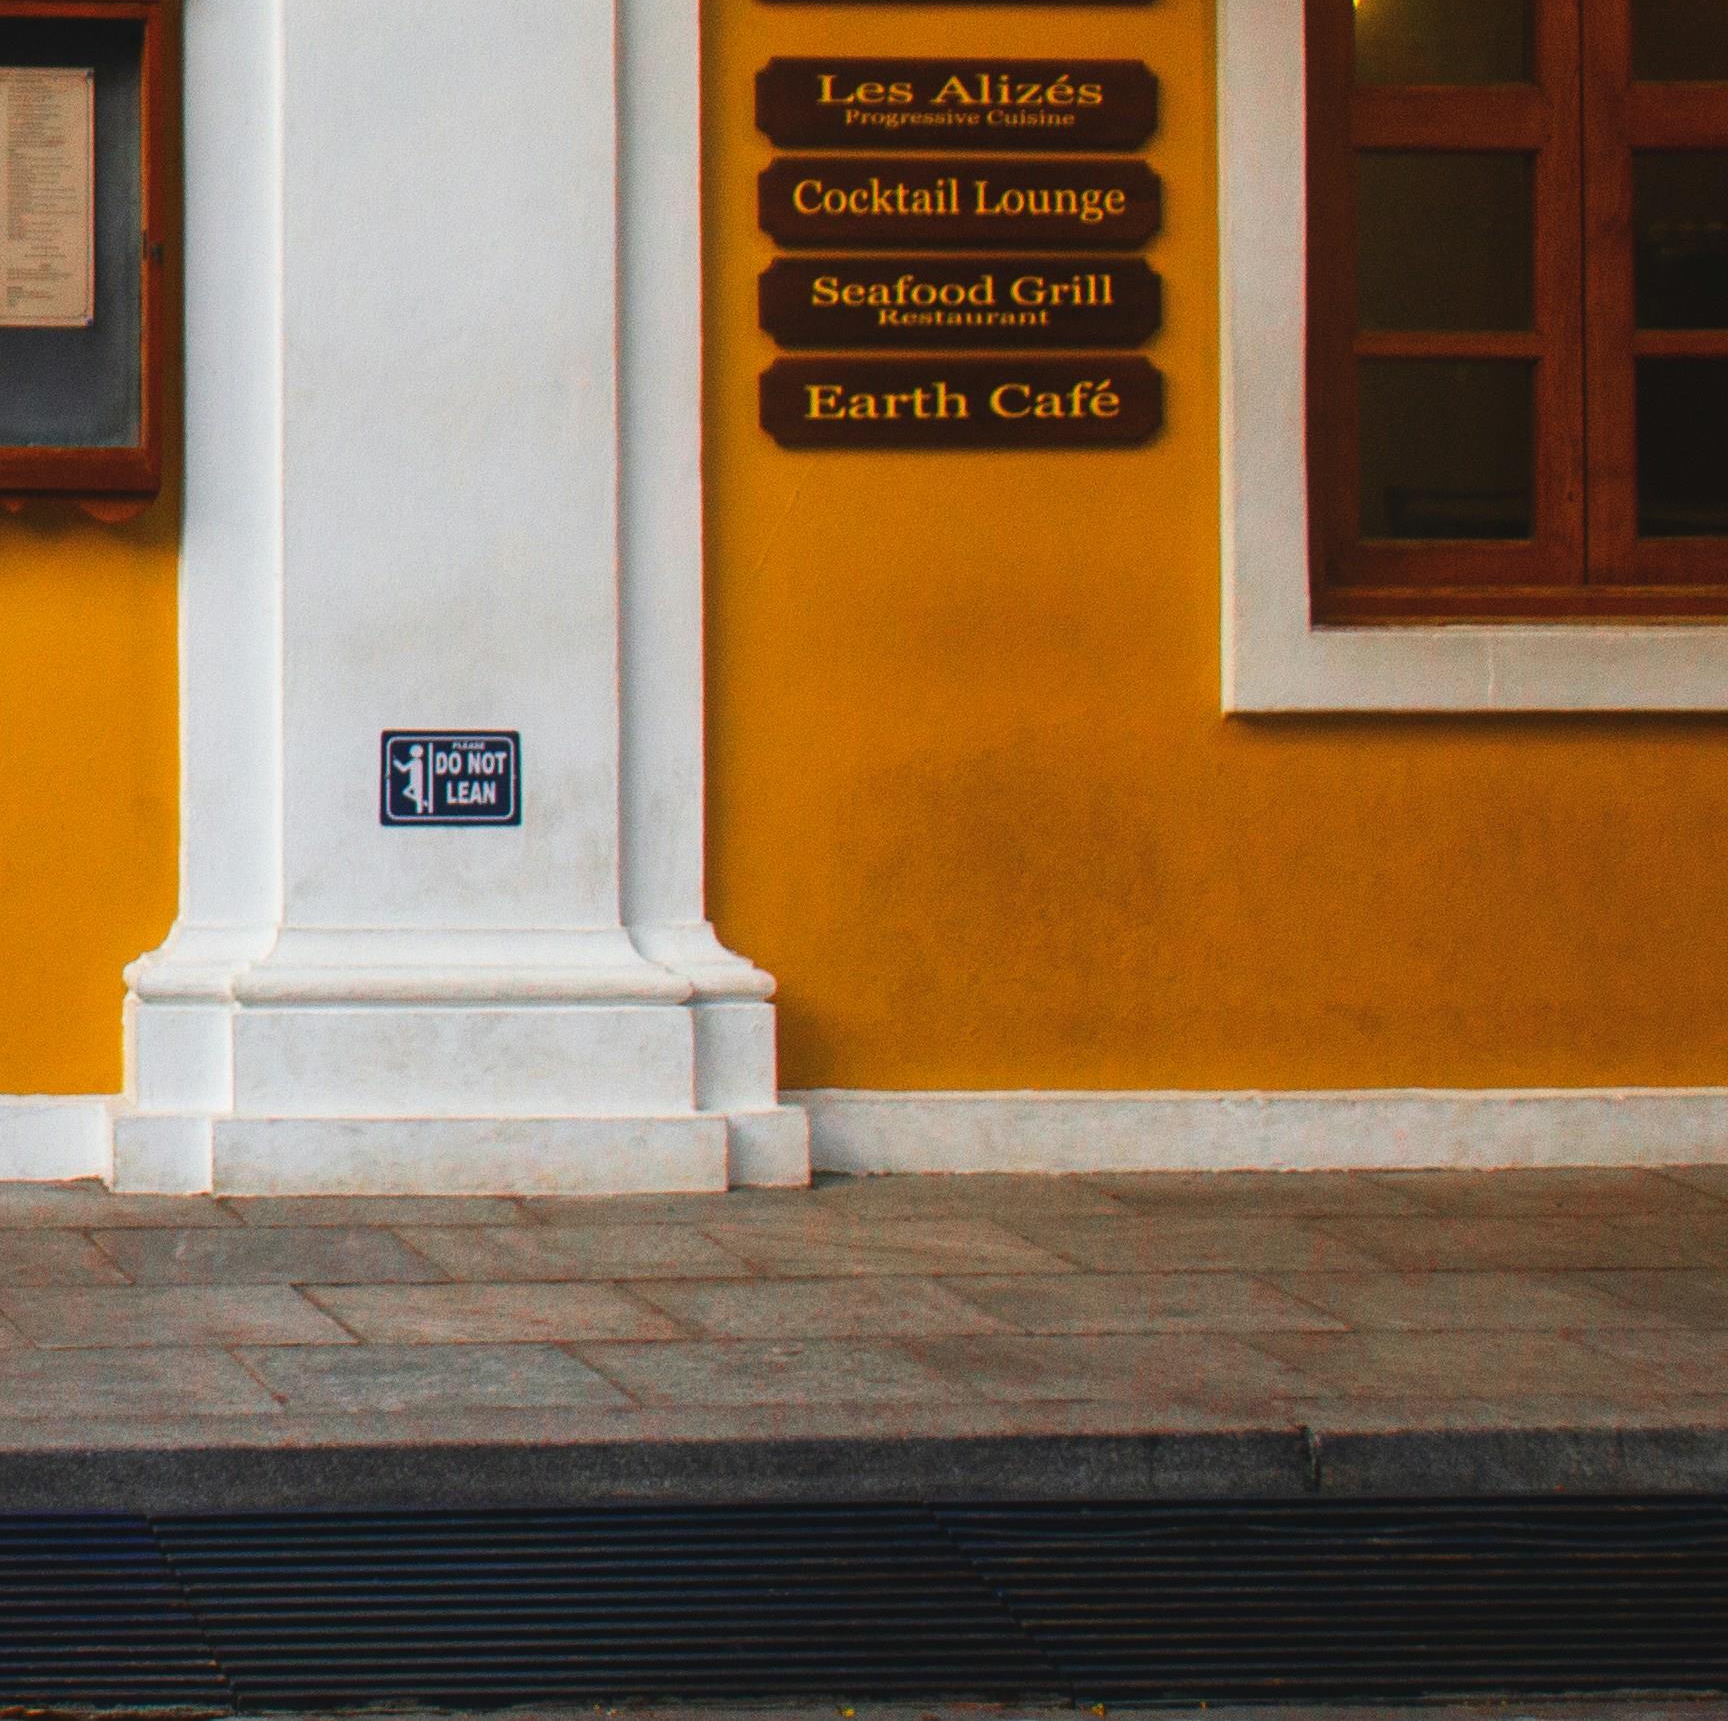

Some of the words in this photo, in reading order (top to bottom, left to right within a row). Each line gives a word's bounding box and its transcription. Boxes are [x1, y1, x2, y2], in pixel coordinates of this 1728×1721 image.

[816, 74, 914, 106] Les
[930, 74, 1105, 106] Alizés
[844, 108, 981, 128] Progressive
[986, 108, 1076, 127] Cuisine
[792, 180, 960, 216] Cocktail
[974, 180, 1127, 224] Lounge
[811, 275, 997, 308] Seafood
[1010, 274, 1114, 307] Grill
[877, 308, 1051, 327] Restaurant
[804, 382, 969, 420] Earth
[989, 379, 1121, 418] Café
[435, 751, 462, 775] DO
[467, 751, 507, 775] NOT
[446, 780, 496, 804] LEAN
